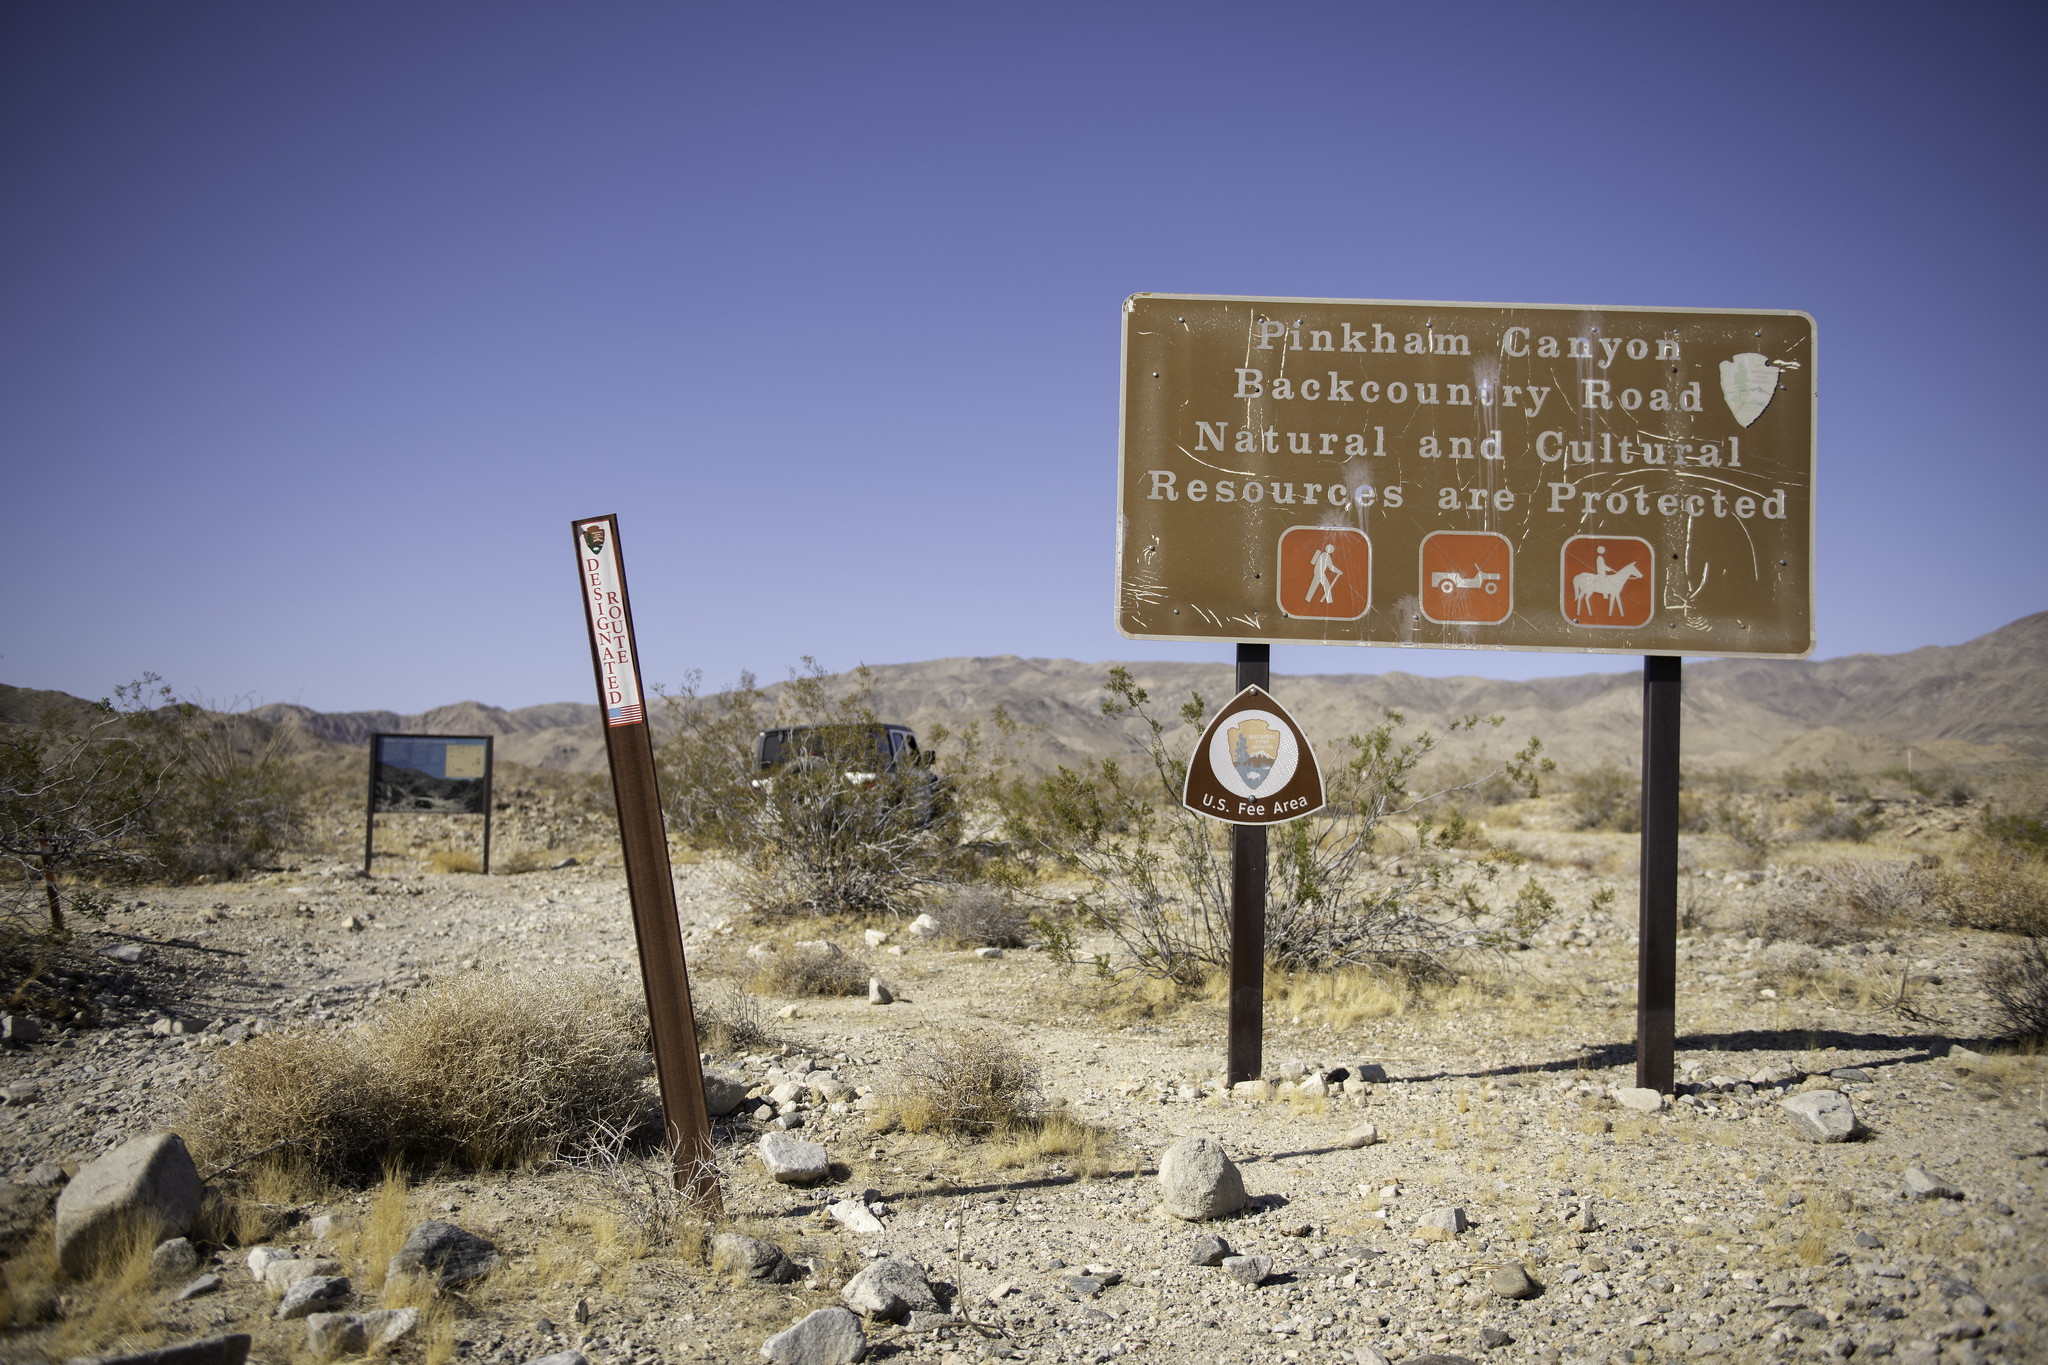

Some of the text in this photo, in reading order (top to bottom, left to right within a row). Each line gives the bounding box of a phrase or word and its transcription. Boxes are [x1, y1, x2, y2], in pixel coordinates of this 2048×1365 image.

[1256, 320, 1681, 369] Pinkham Canyon
[1233, 367, 1703, 418] Backcountry Road
[1194, 420, 1742, 467] Natural and Cultural
[1146, 469, 1787, 520] Resources are Protected
[587, 558, 622, 704] DESIGNATED
[606, 591, 629, 664] ROUTE
[1202, 793, 1308, 815] U.S. Fee Area
